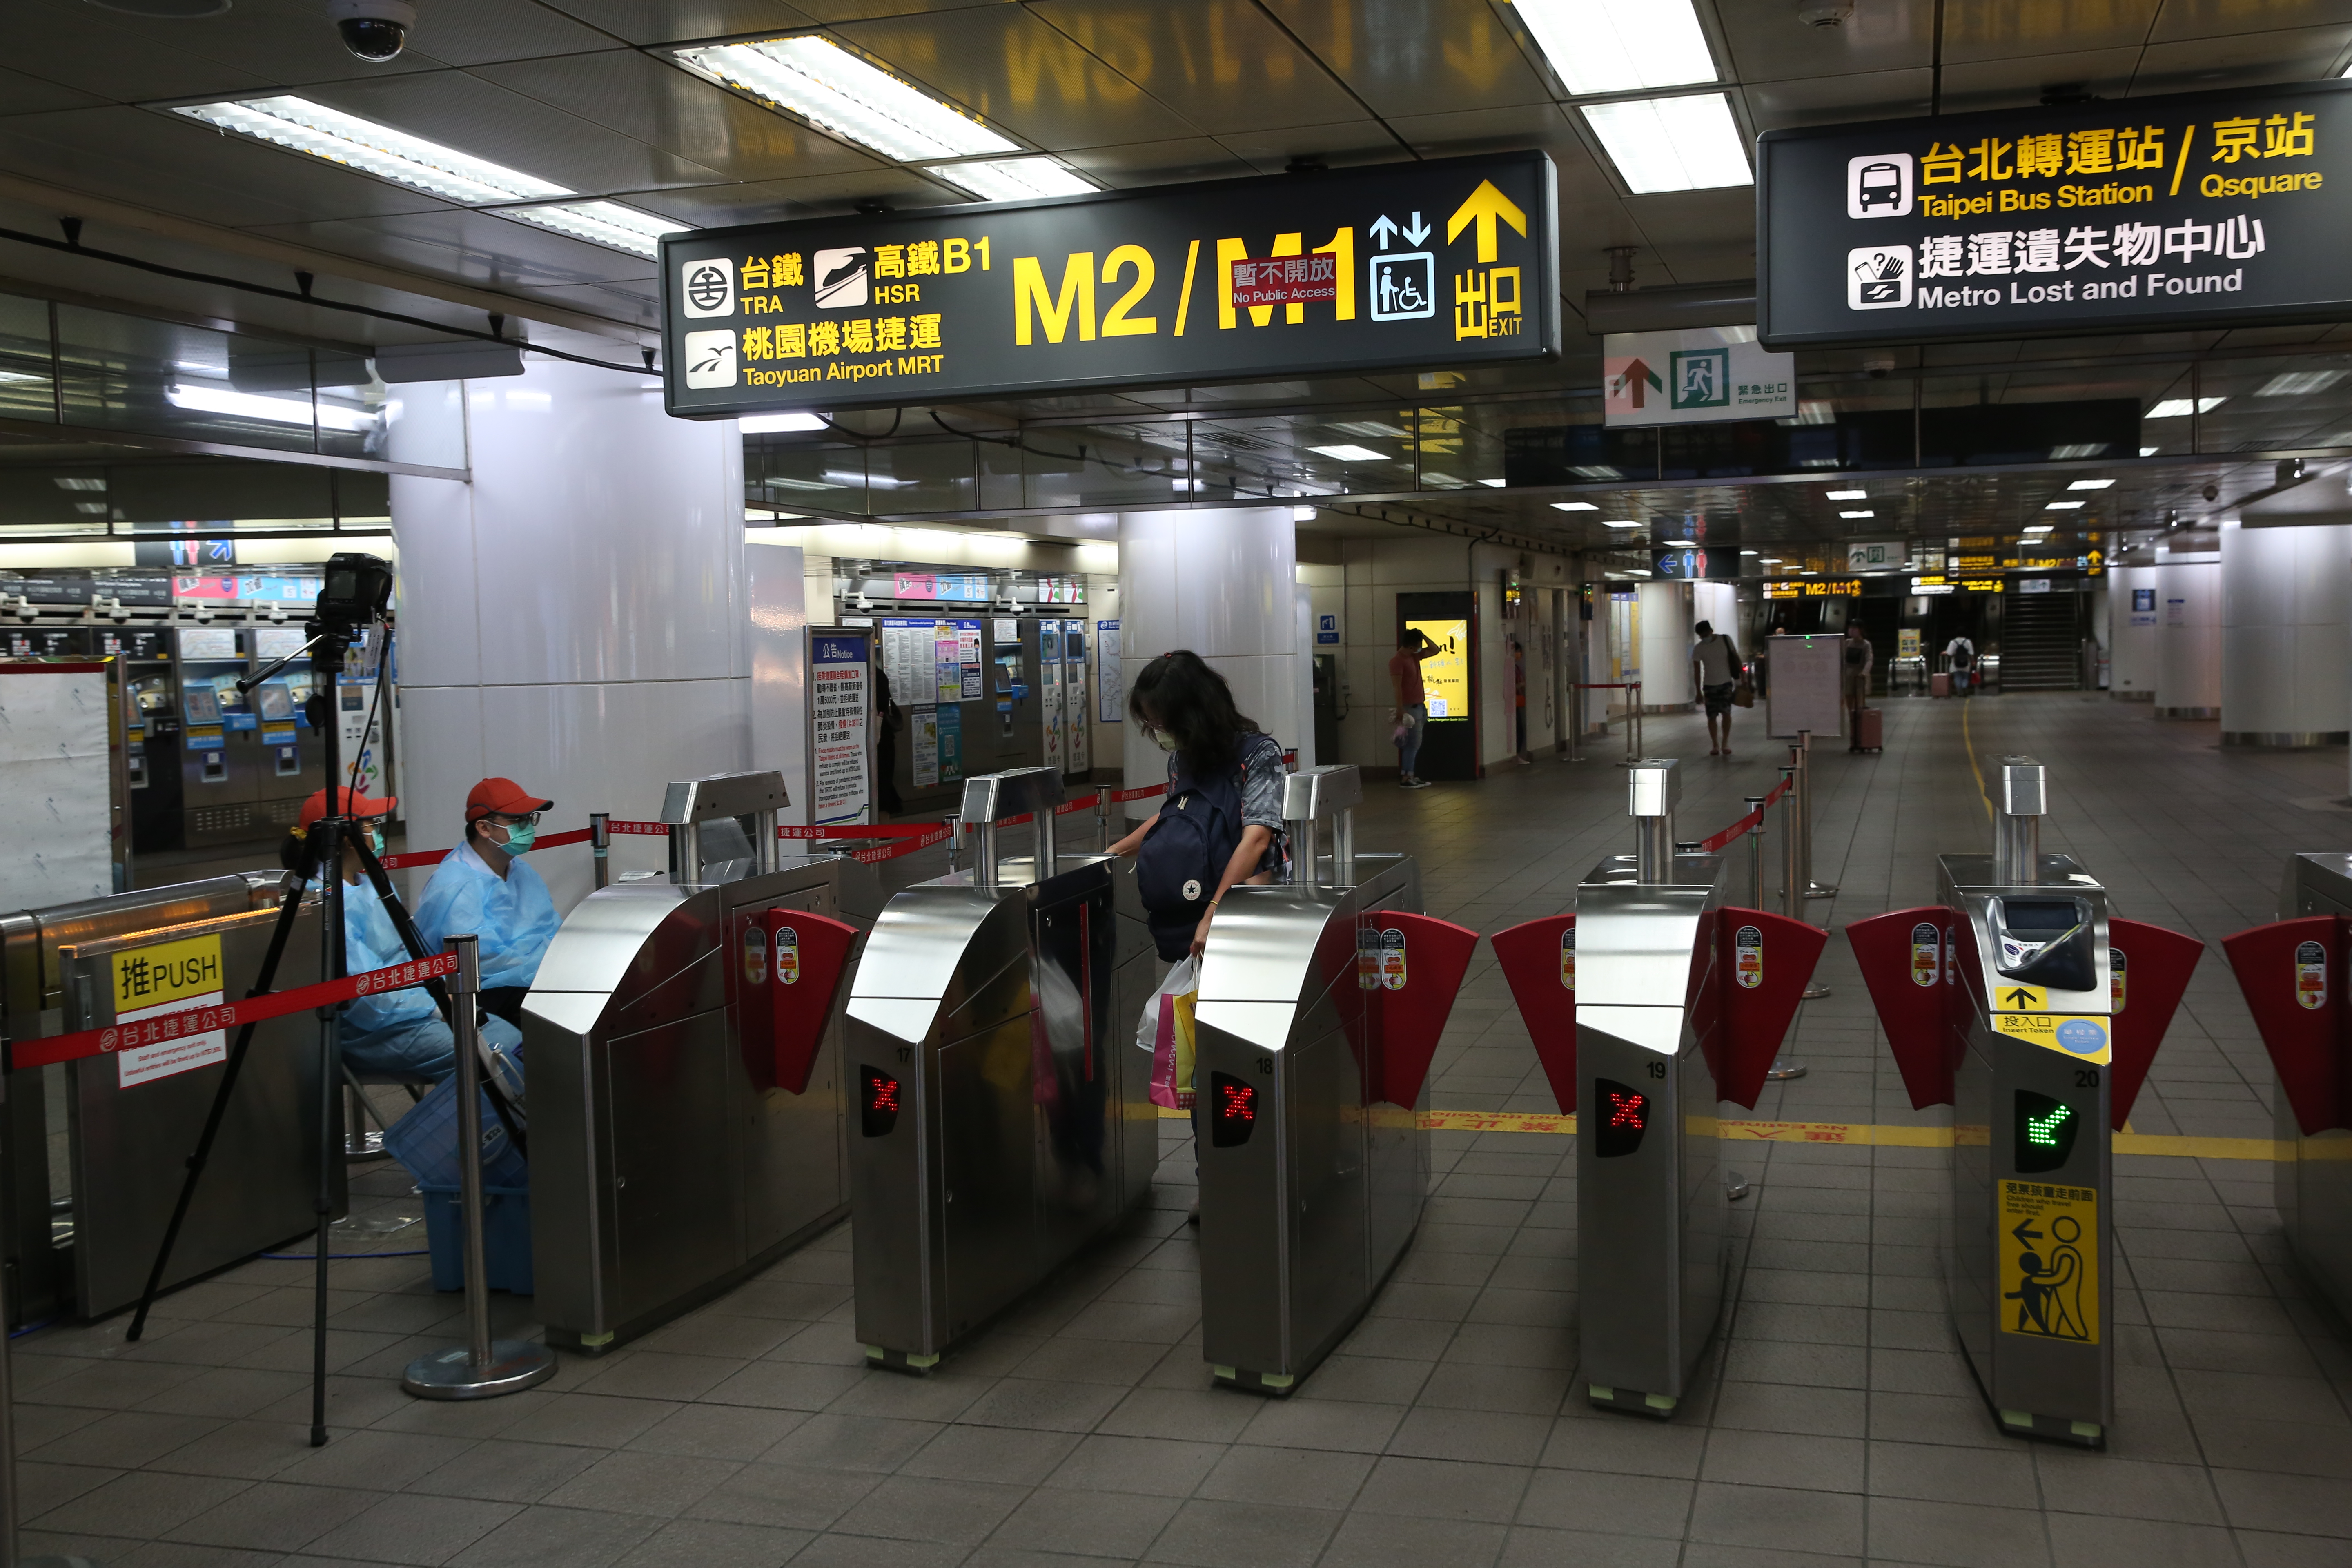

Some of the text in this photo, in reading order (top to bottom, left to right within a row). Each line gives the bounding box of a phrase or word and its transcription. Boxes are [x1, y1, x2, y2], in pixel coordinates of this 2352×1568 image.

[1920, 126, 2165, 187] 台北轉運站
[2210, 111, 2315, 163] 京站
[1918, 170, 2323, 220] Taipei Bus Station Qsquare
[1918, 214, 2266, 280] 捷運遺失物中心
[739, 252, 804, 290] 台鐵
[1233, 257, 1336, 288] 暫不開放
[740, 284, 920, 315] TRA HSR
[1013, 243, 1157, 345] M2
[1233, 285, 1336, 304] No Public Access
[1455, 266, 1521, 341] 出口
[1918, 268, 2243, 310] Metro Lost and Found
[742, 313, 942, 361] 桃園機場捷運
[1489, 317, 1522, 336] EXIT
[743, 354, 944, 387] Taoyuan Airport MRT
[1738, 383, 1787, 396] 緊急出口
[1738, 396, 1773, 405] Emergency
[823, 643, 837, 658] 公告
[837, 650, 853, 658] Notice
[153, 955, 217, 992] PUSH
[373, 955, 458, 990] 台北捷運公司
[123, 1007, 235, 1047] 台北捷運公司
[2004, 1016, 2051, 1027] 投入口
[897, 1047, 911, 1062] 17
[1256, 1058, 1272, 1074] 18
[1647, 1062, 1666, 1079] 19
[2075, 1070, 2099, 1087] 20
[2006, 1195, 2034, 1203] Children
